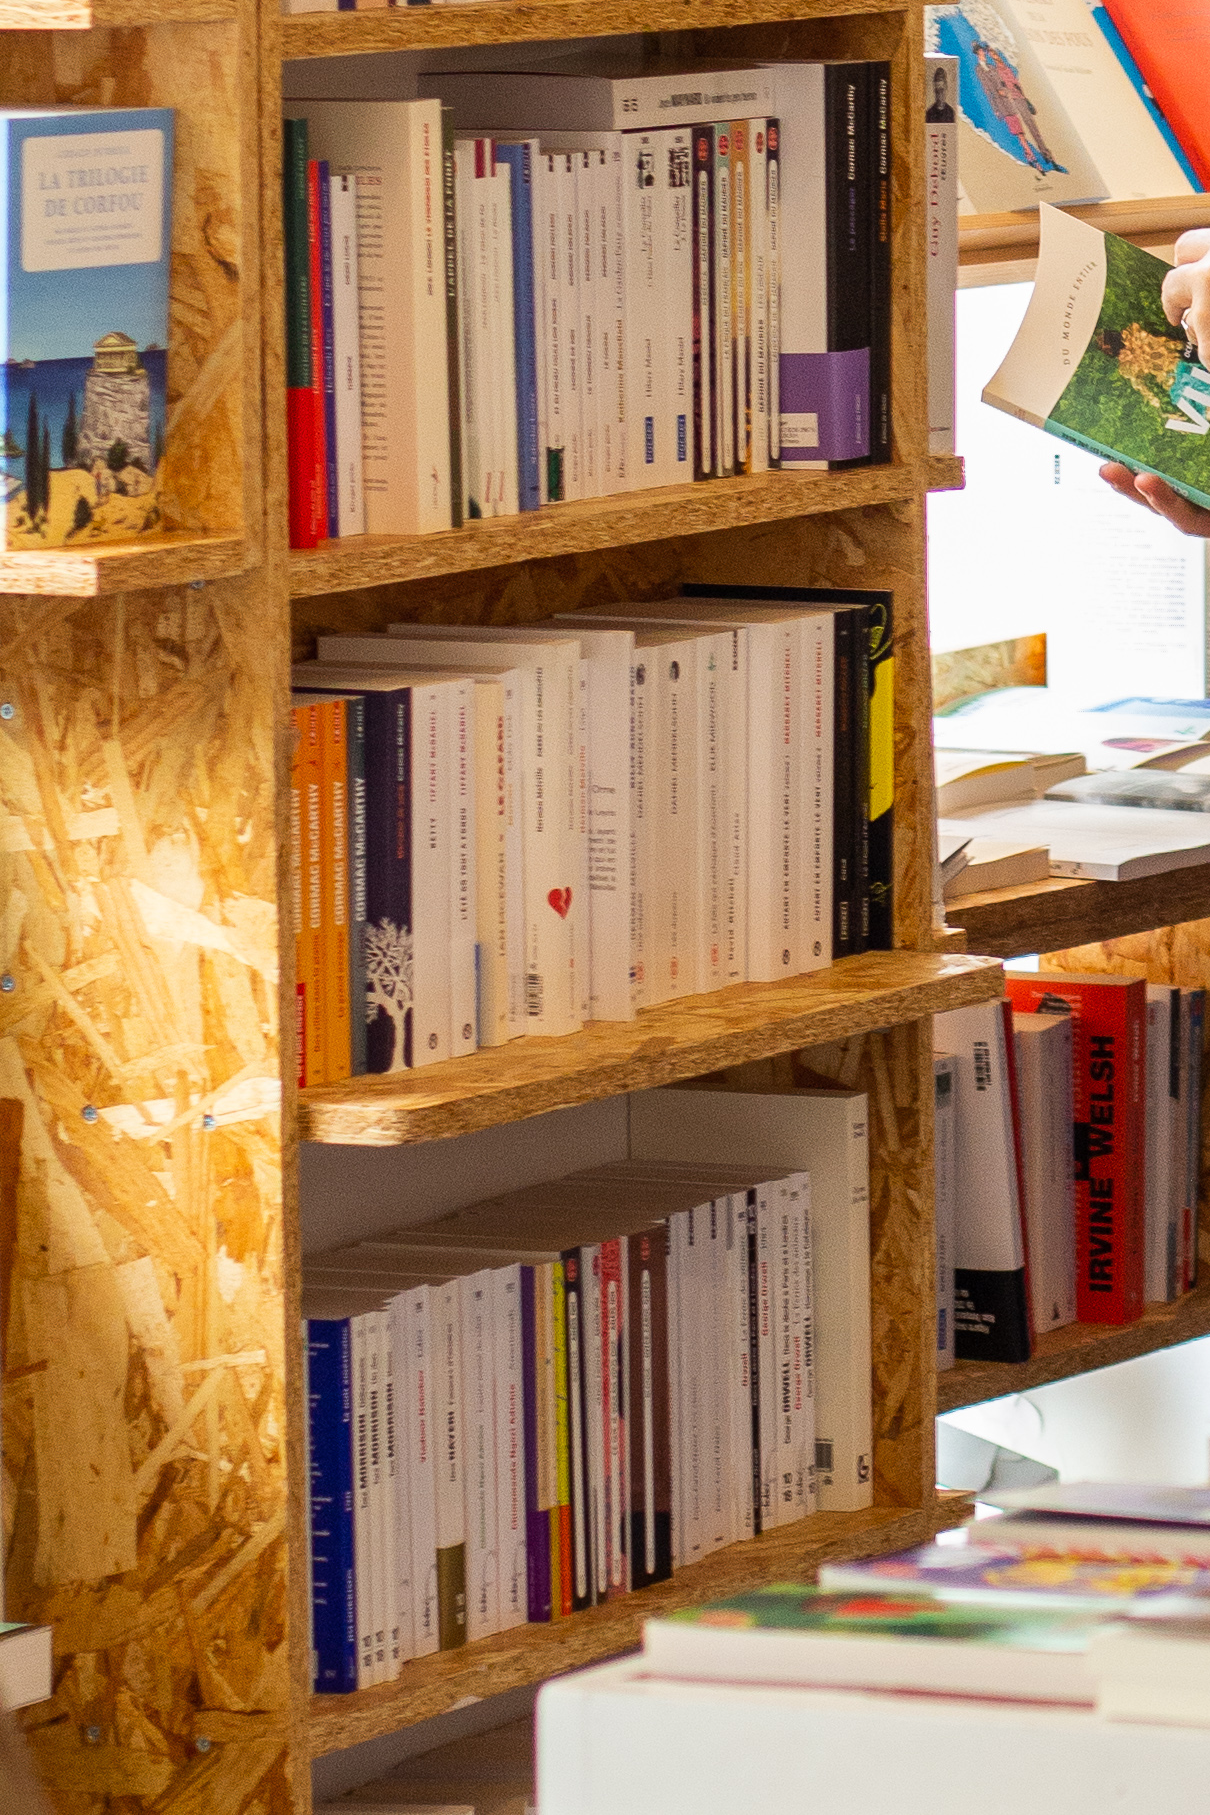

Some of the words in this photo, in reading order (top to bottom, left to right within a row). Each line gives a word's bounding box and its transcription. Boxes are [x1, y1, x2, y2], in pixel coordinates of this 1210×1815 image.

[846, 83, 858, 136] McCarthy
[877, 78, 889, 130] McCarthy
[38, 171, 61, 190] LA
[66, 165, 149, 188] TRILOGIE
[846, 139, 856, 181] Cormac
[878, 132, 888, 175] Cormac
[44, 198, 66, 217] DE
[73, 192, 144, 215] CORFOU
[1072, 261, 1098, 290] ENTIER
[1062, 294, 1076, 341] MONDE
[1062, 348, 1071, 366] DU
[307, 784, 320, 860] McCARTHY
[332, 781, 345, 858] McCARTHY
[307, 863, 321, 929] CORMAC
[332, 860, 346, 926] CORMAC
[1089, 1035, 1115, 1160] WELSH
[1088, 1176, 1115, 1293] IRVINE
[357, 1413, 367, 1490] MORRISON
[370, 1389, 380, 1466] MORRISON
